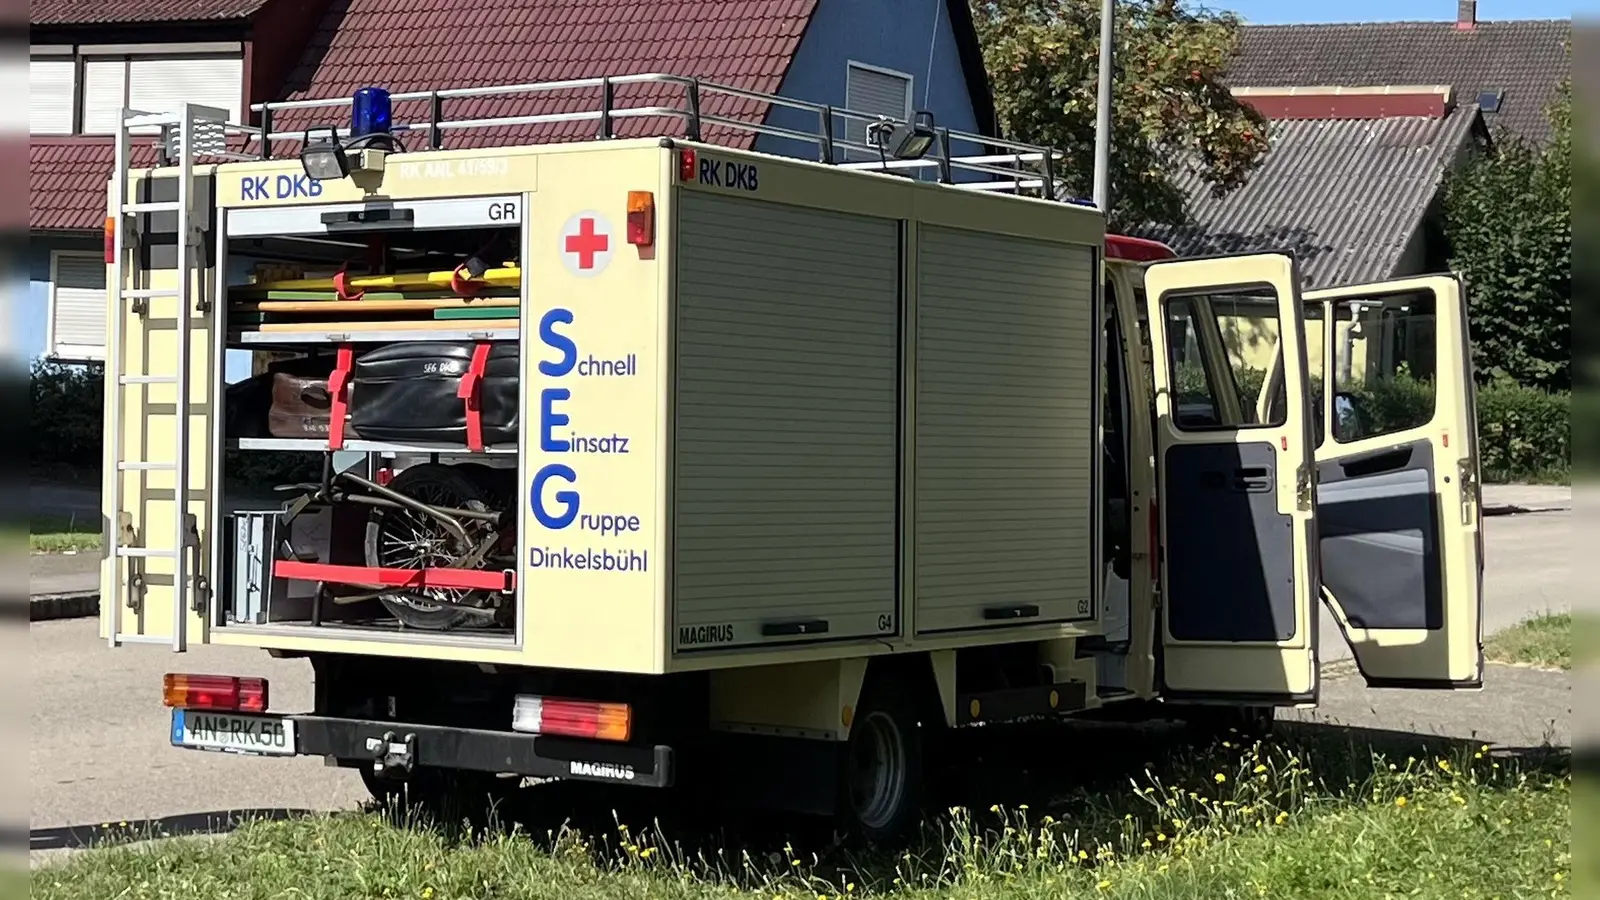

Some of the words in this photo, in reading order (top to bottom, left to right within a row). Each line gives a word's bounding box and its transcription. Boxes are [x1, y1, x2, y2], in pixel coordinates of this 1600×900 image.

[700, 158, 721, 187] RK
[725, 162, 758, 191] DKB
[241, 177, 269, 200] RK
[277, 175, 323, 198] DKB
[488, 203, 516, 220] GR
[538, 308, 636, 377] Schnell
[540, 388, 629, 453] Einsatz
[530, 463, 640, 537] Gruppe
[530, 546, 647, 572] Dinkelsbühl
[1077, 600, 1089, 614] G2
[679, 624, 734, 644] MAGIRUS
[878, 614, 892, 631] G4
[191, 716, 218, 741] AN
[570, 760, 635, 780] MAGIRUS
